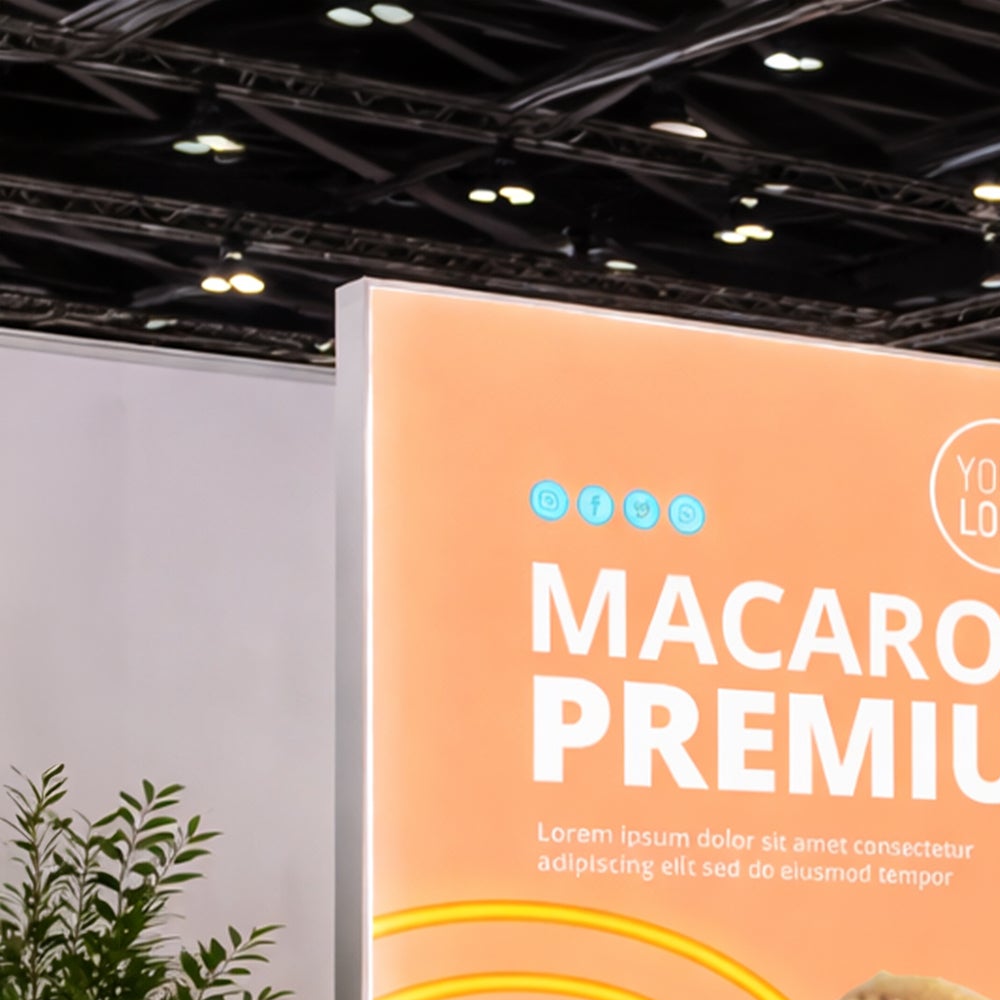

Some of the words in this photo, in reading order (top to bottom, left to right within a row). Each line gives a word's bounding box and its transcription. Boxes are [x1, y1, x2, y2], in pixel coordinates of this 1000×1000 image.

[537, 820, 614, 845] Lorem
[620, 825, 691, 852] ipsum
[696, 826, 757, 852] dolor
[760, 831, 788, 853] sit
[792, 836, 849, 856] amet
[852, 838, 976, 860] consectetur
[536, 851, 656, 882] adipiscing
[660, 855, 698, 877] elit
[702, 857, 742, 879] sed
[747, 858, 776, 880] do
[780, 860, 873, 884] eiusmod
[878, 866, 955, 892] tempor
